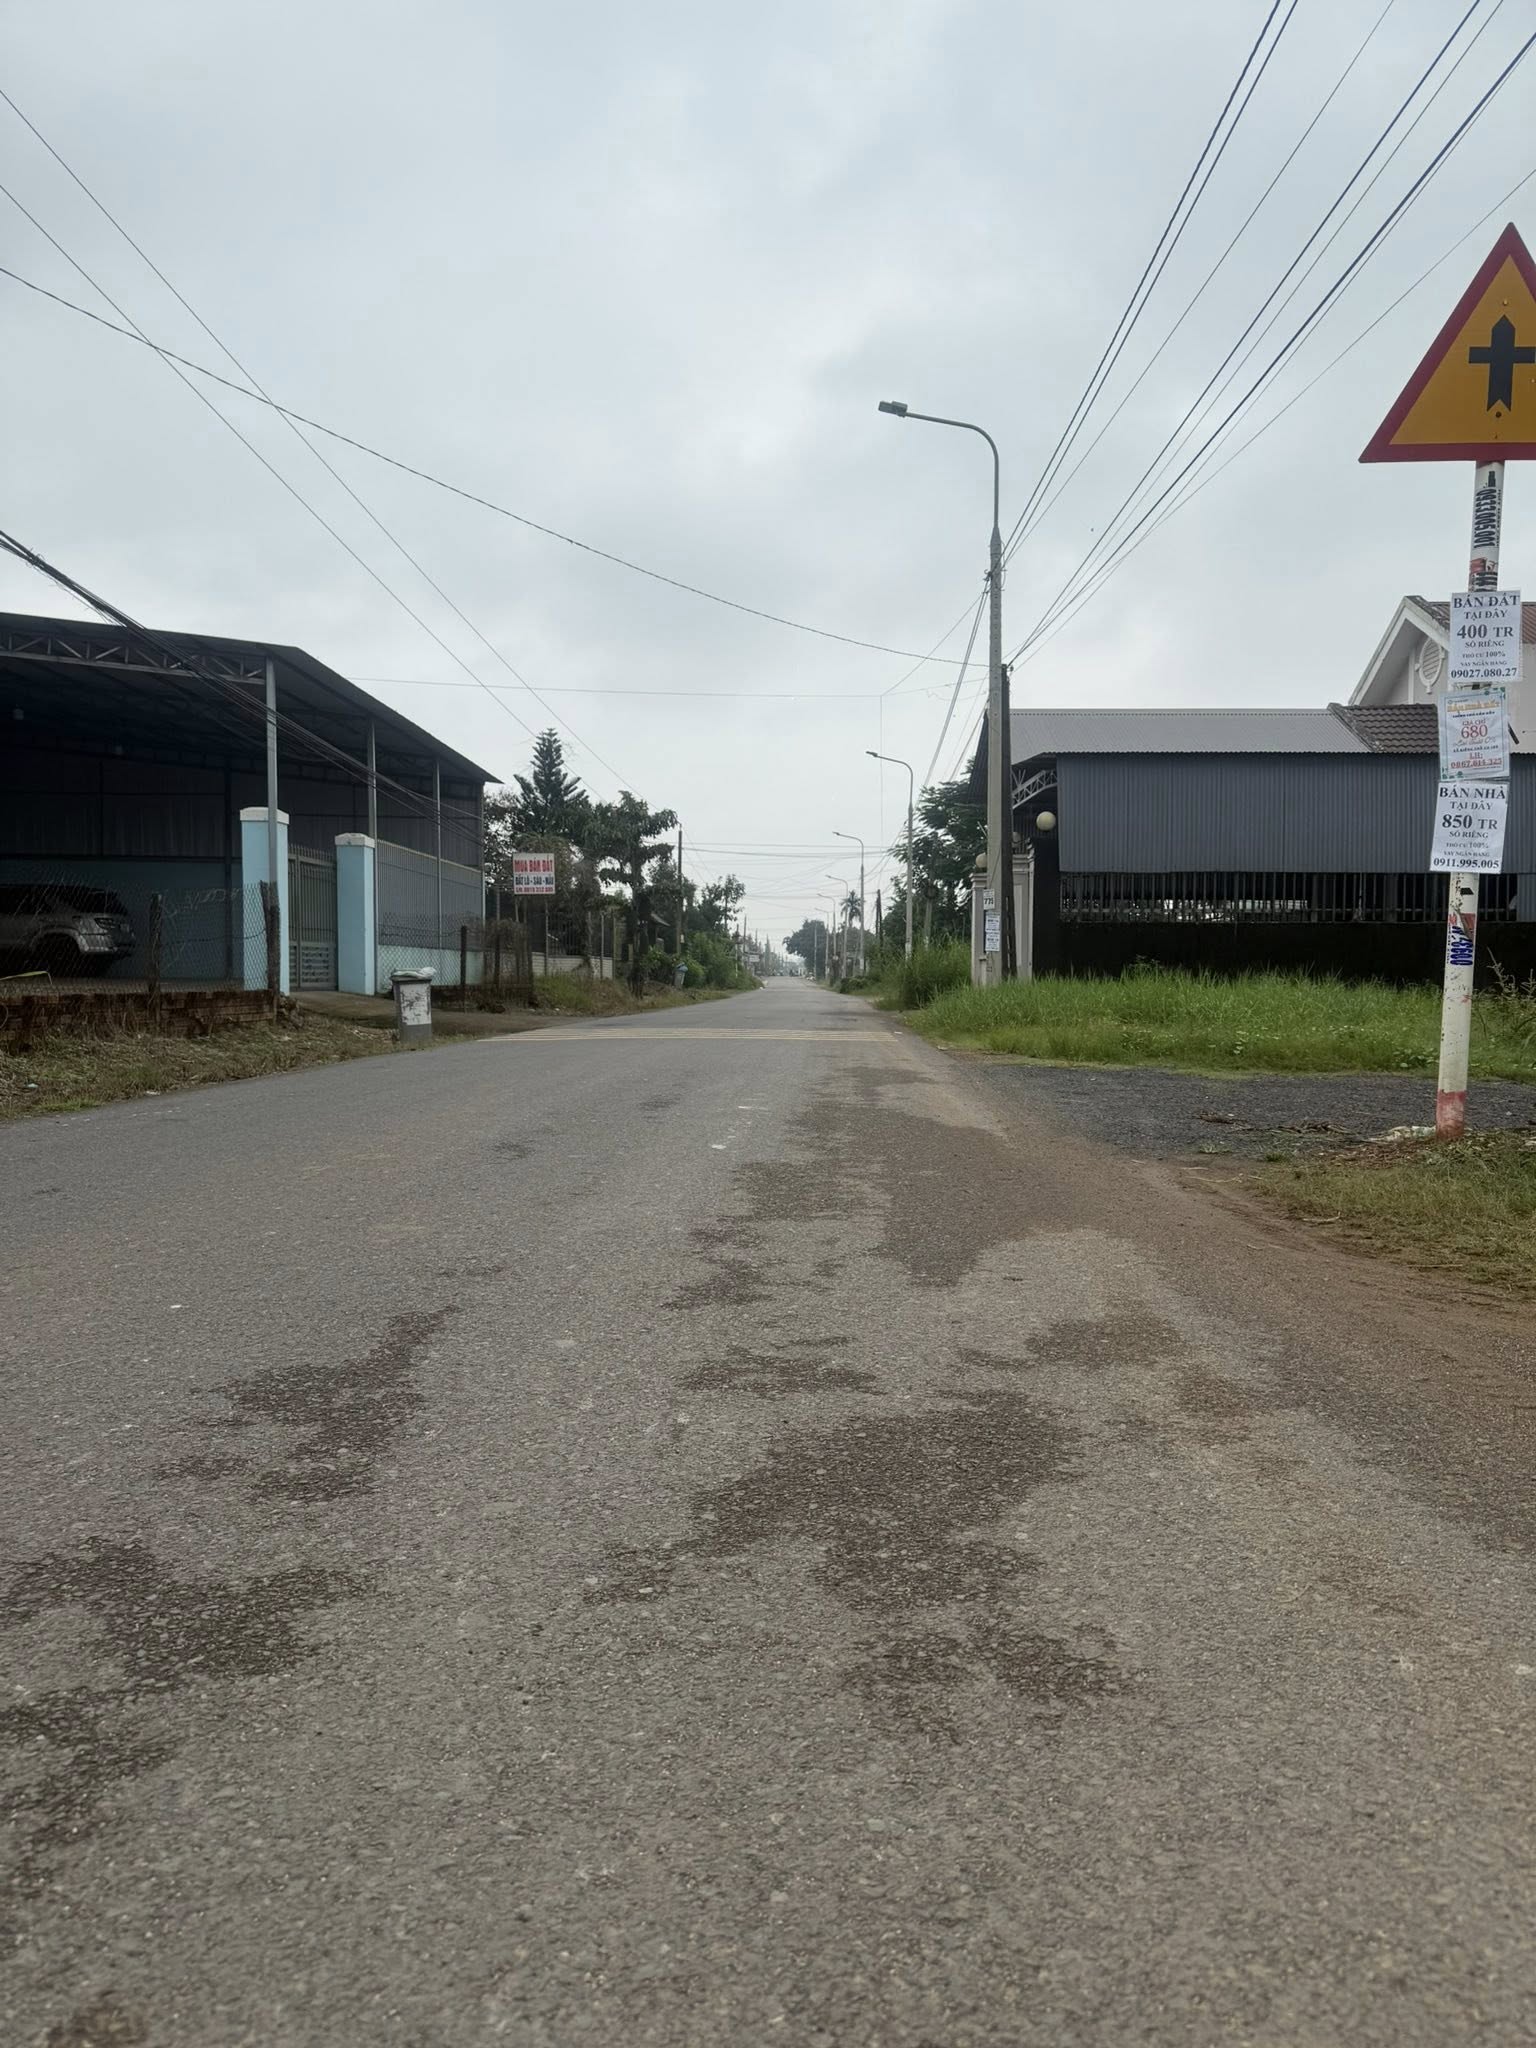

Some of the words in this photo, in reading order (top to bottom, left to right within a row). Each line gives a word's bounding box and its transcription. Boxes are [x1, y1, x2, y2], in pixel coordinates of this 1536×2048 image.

[1453, 594, 1483, 608] BÁN
[1464, 611, 1482, 621] TẠI
[1485, 608, 1508, 618] ĐÂY
[1457, 624, 1488, 639] 400
[1493, 626, 1514, 638] TR
[1451, 668, 1517, 678] 09027.080.27
[1461, 725, 1488, 739] 680
[1440, 785, 1469, 798] BÁN
[1474, 786, 1505, 799] NHÀ
[1450, 801, 1468, 811] TẠI
[1442, 814, 1472, 829] 850
[1478, 819, 1498, 829] TR
[1433, 858, 1500, 869] 0911.995.005
